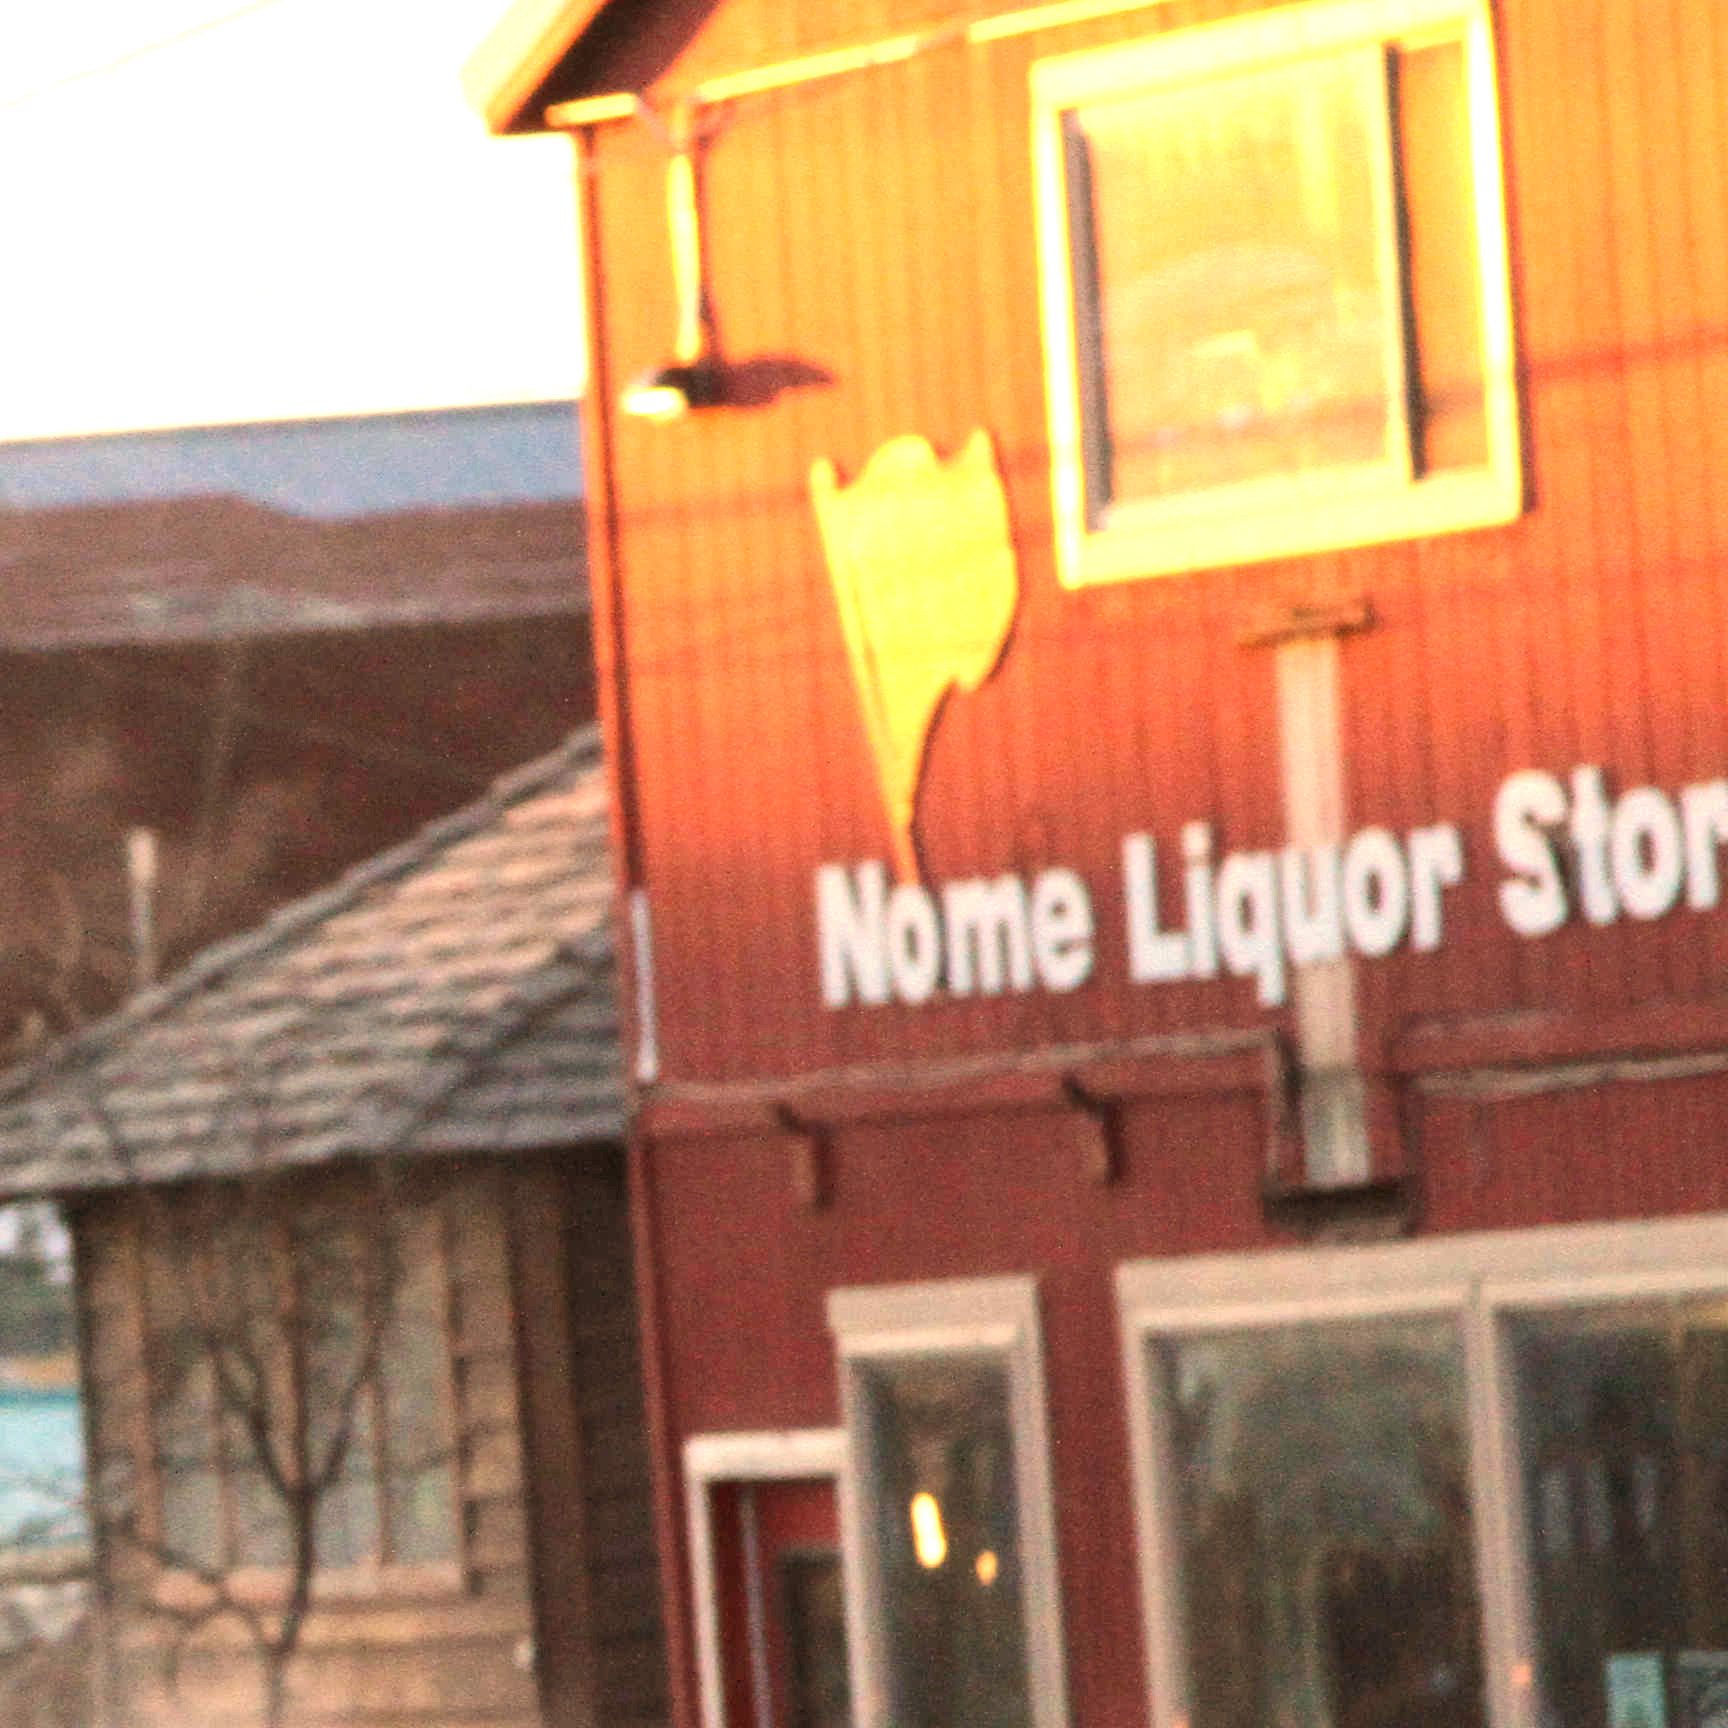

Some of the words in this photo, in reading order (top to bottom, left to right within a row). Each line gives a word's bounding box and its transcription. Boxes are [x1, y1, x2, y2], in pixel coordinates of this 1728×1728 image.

[815, 858, 1096, 1010] Nome
[1120, 820, 1466, 1007] Liquor
[1493, 763, 1728, 938] Stor
